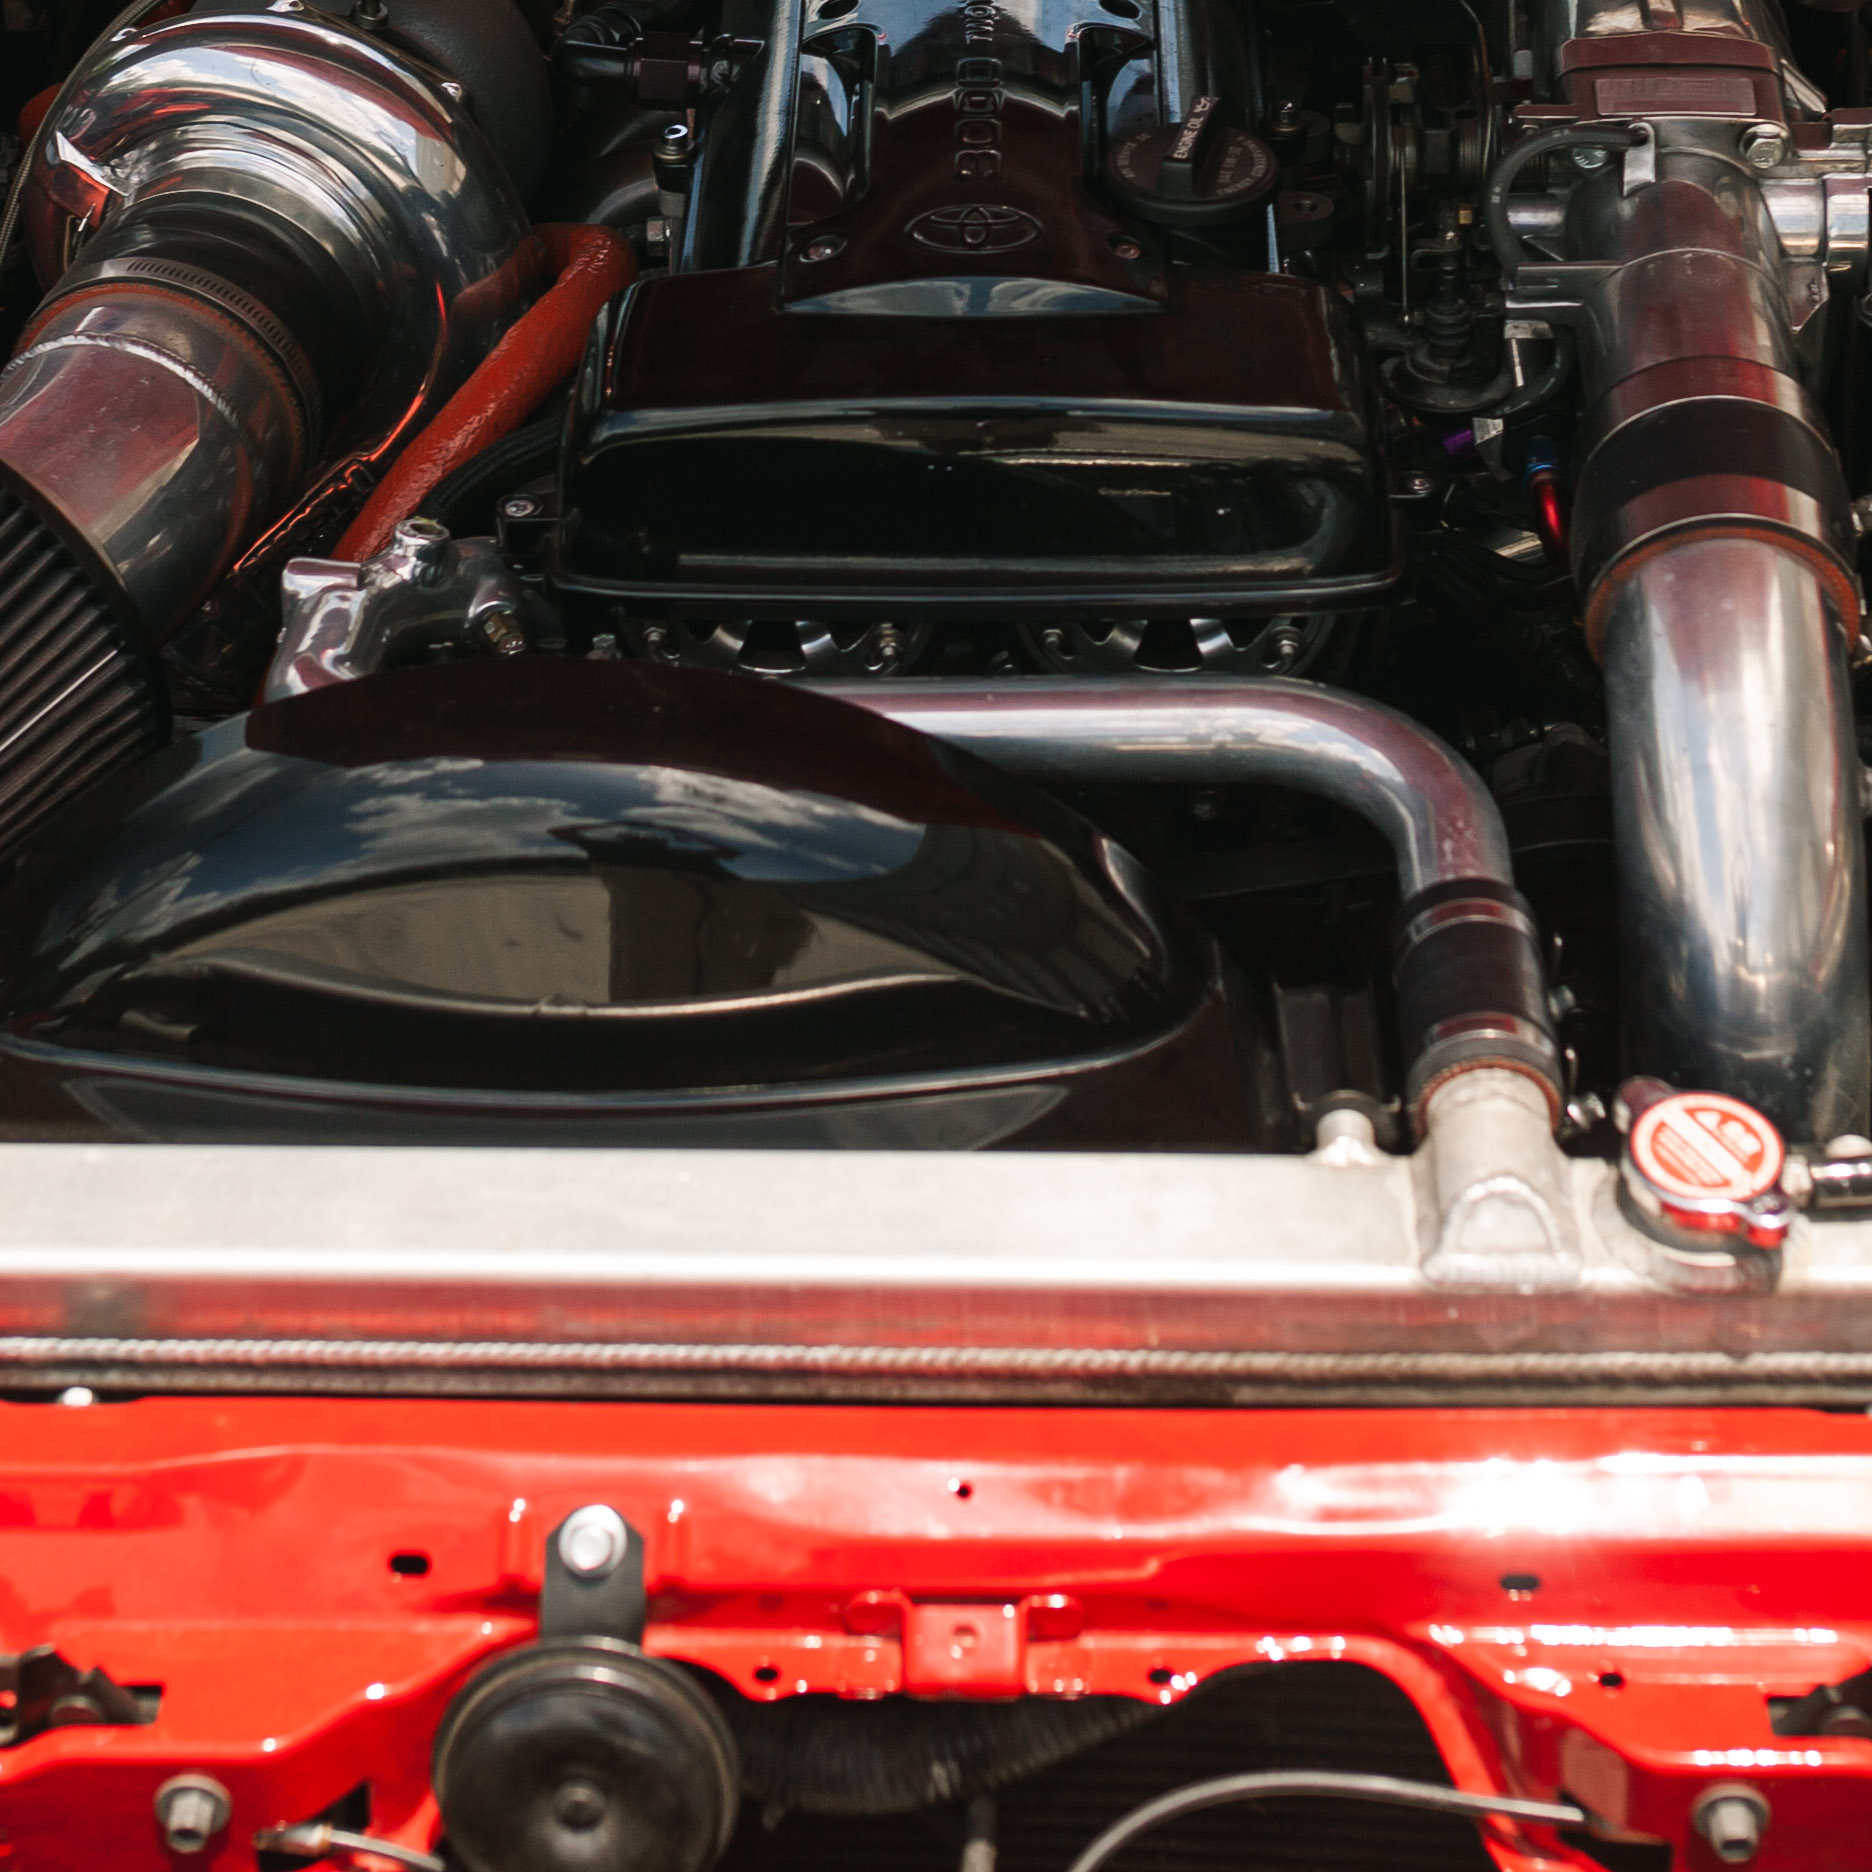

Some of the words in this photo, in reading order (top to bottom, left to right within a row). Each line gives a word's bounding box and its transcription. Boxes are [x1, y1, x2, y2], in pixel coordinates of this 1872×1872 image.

[954, 57, 1002, 182] 3000
[1173, 129, 1199, 159] ENGINE
[1187, 117, 1204, 129] OIL
